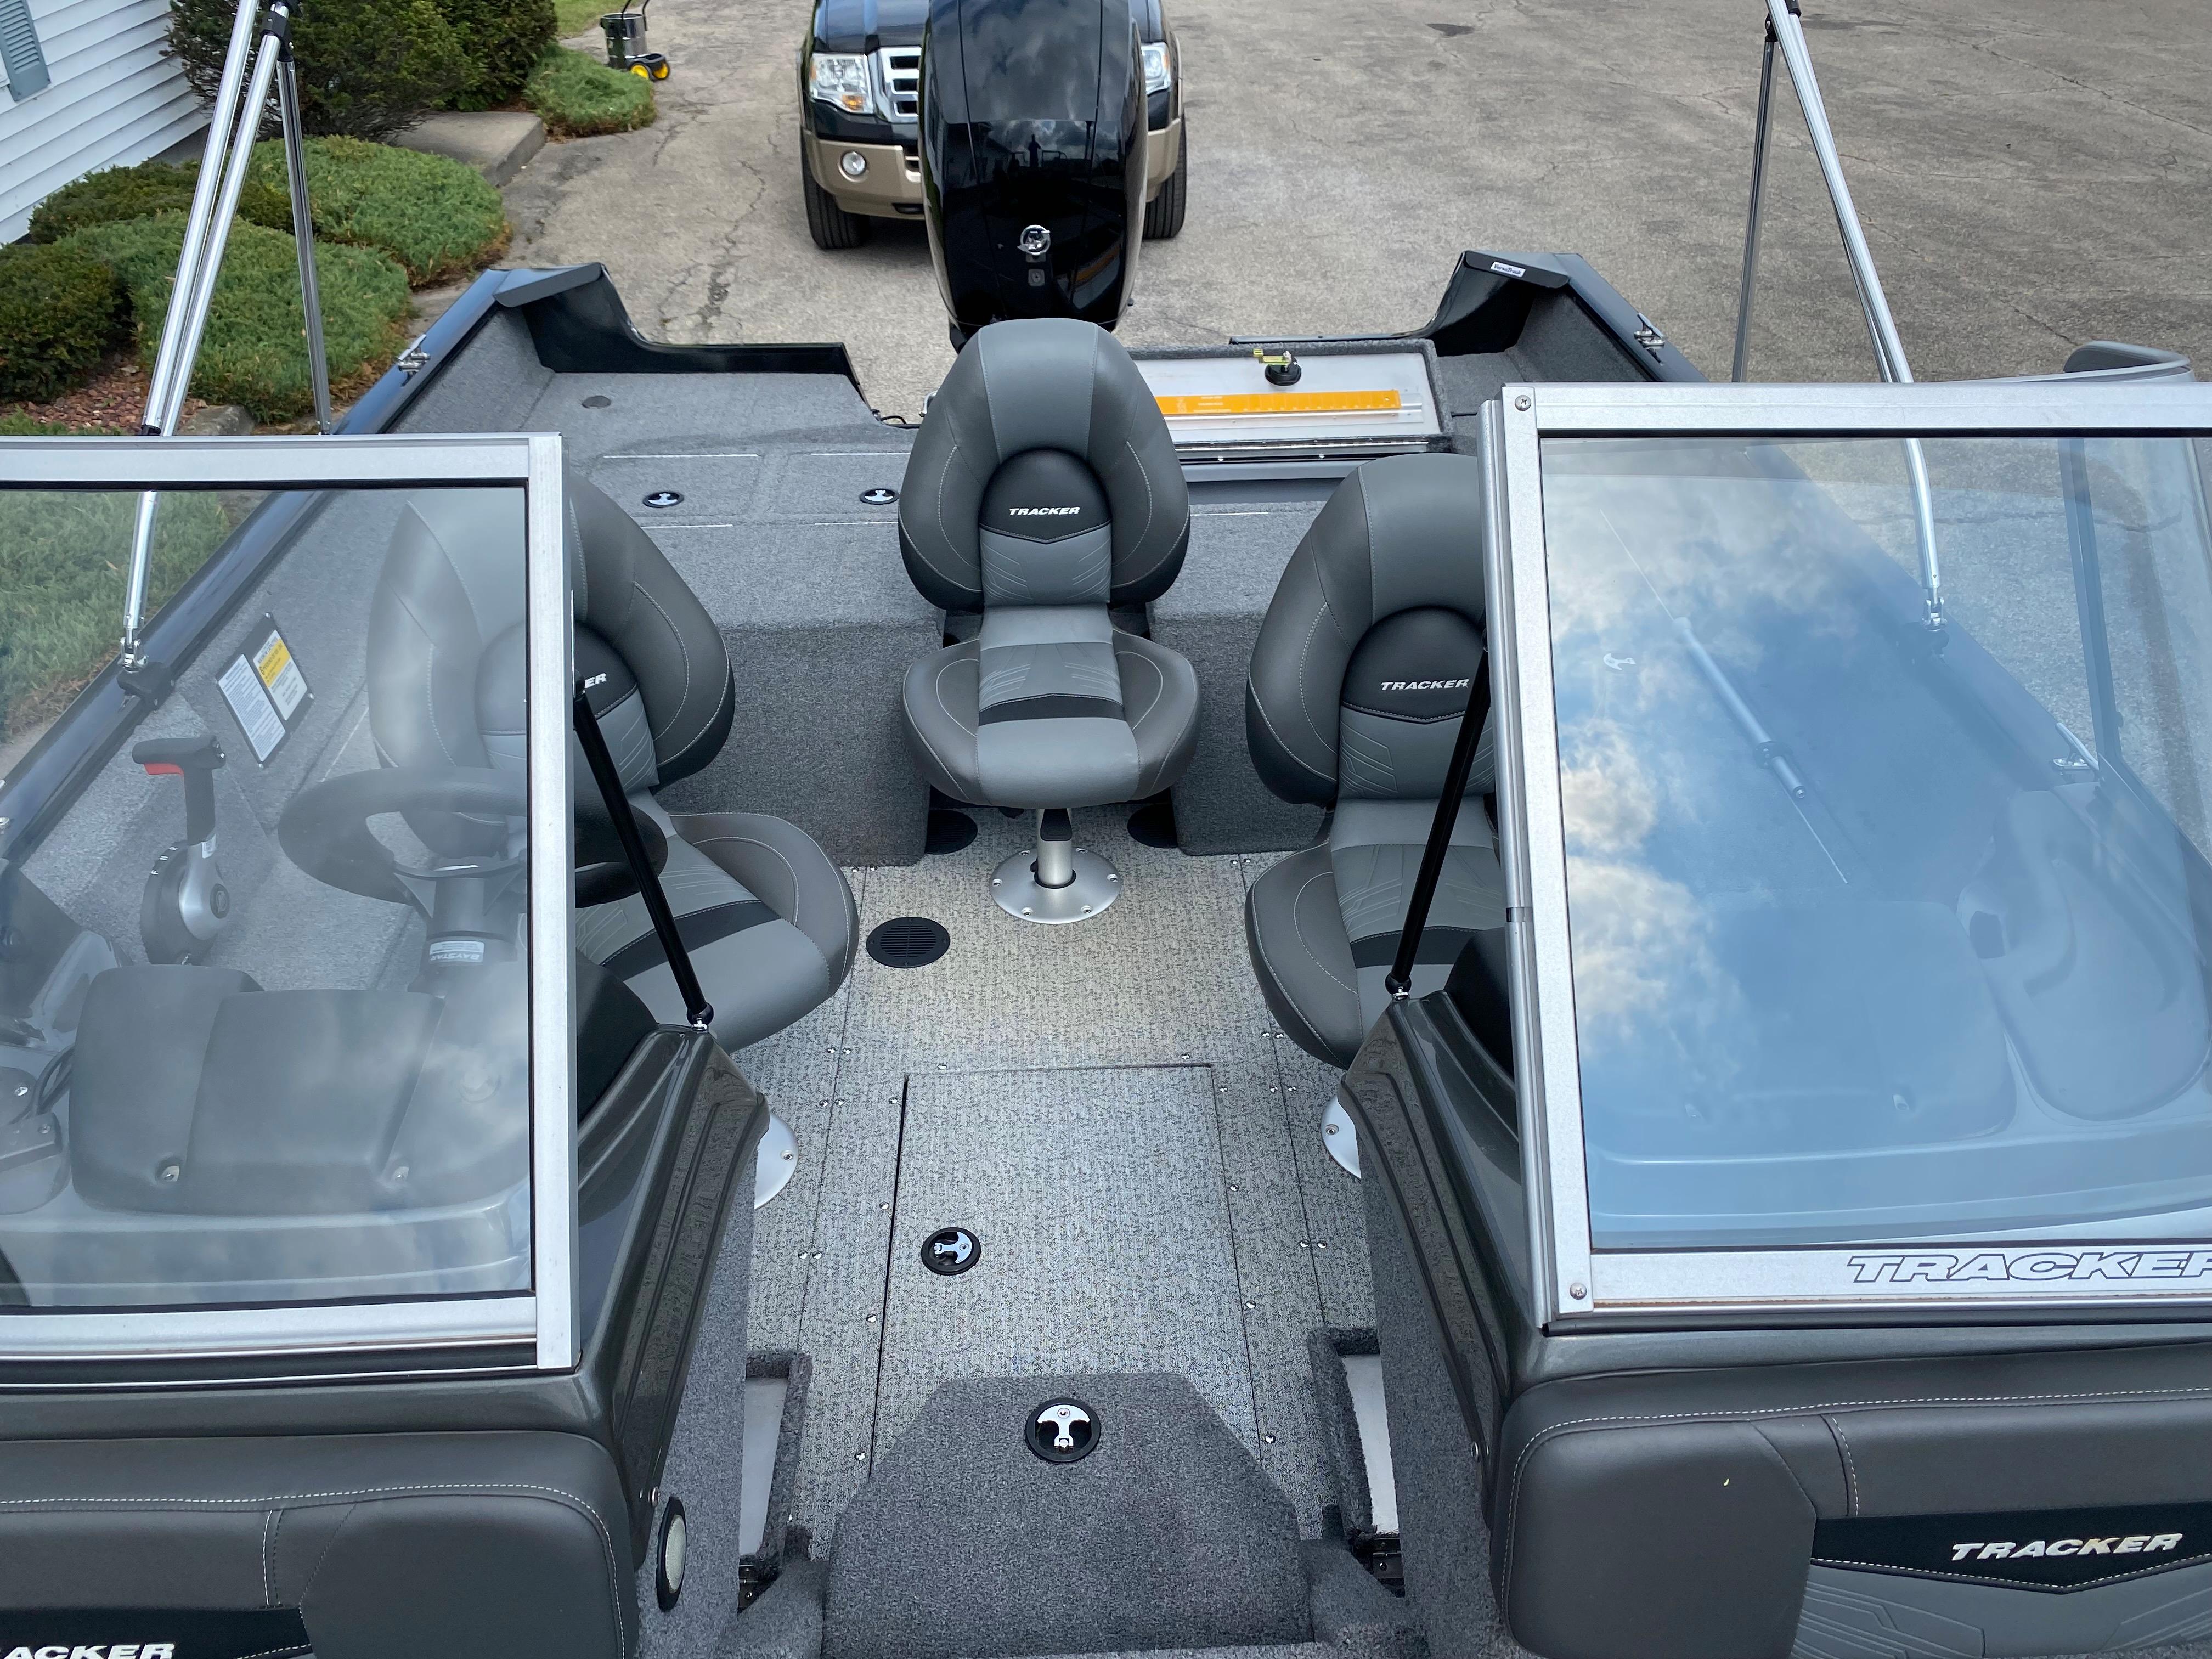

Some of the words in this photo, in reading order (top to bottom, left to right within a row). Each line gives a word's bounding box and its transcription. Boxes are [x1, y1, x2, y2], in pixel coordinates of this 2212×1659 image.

[1009, 507, 1080, 515] TRACKER
[1380, 678, 1470, 691] TRACKER
[430, 952, 481, 961] BAYSTAR
[1951, 1533, 2184, 1561] TRACKER
[0, 1643, 175, 1659] ACKER
